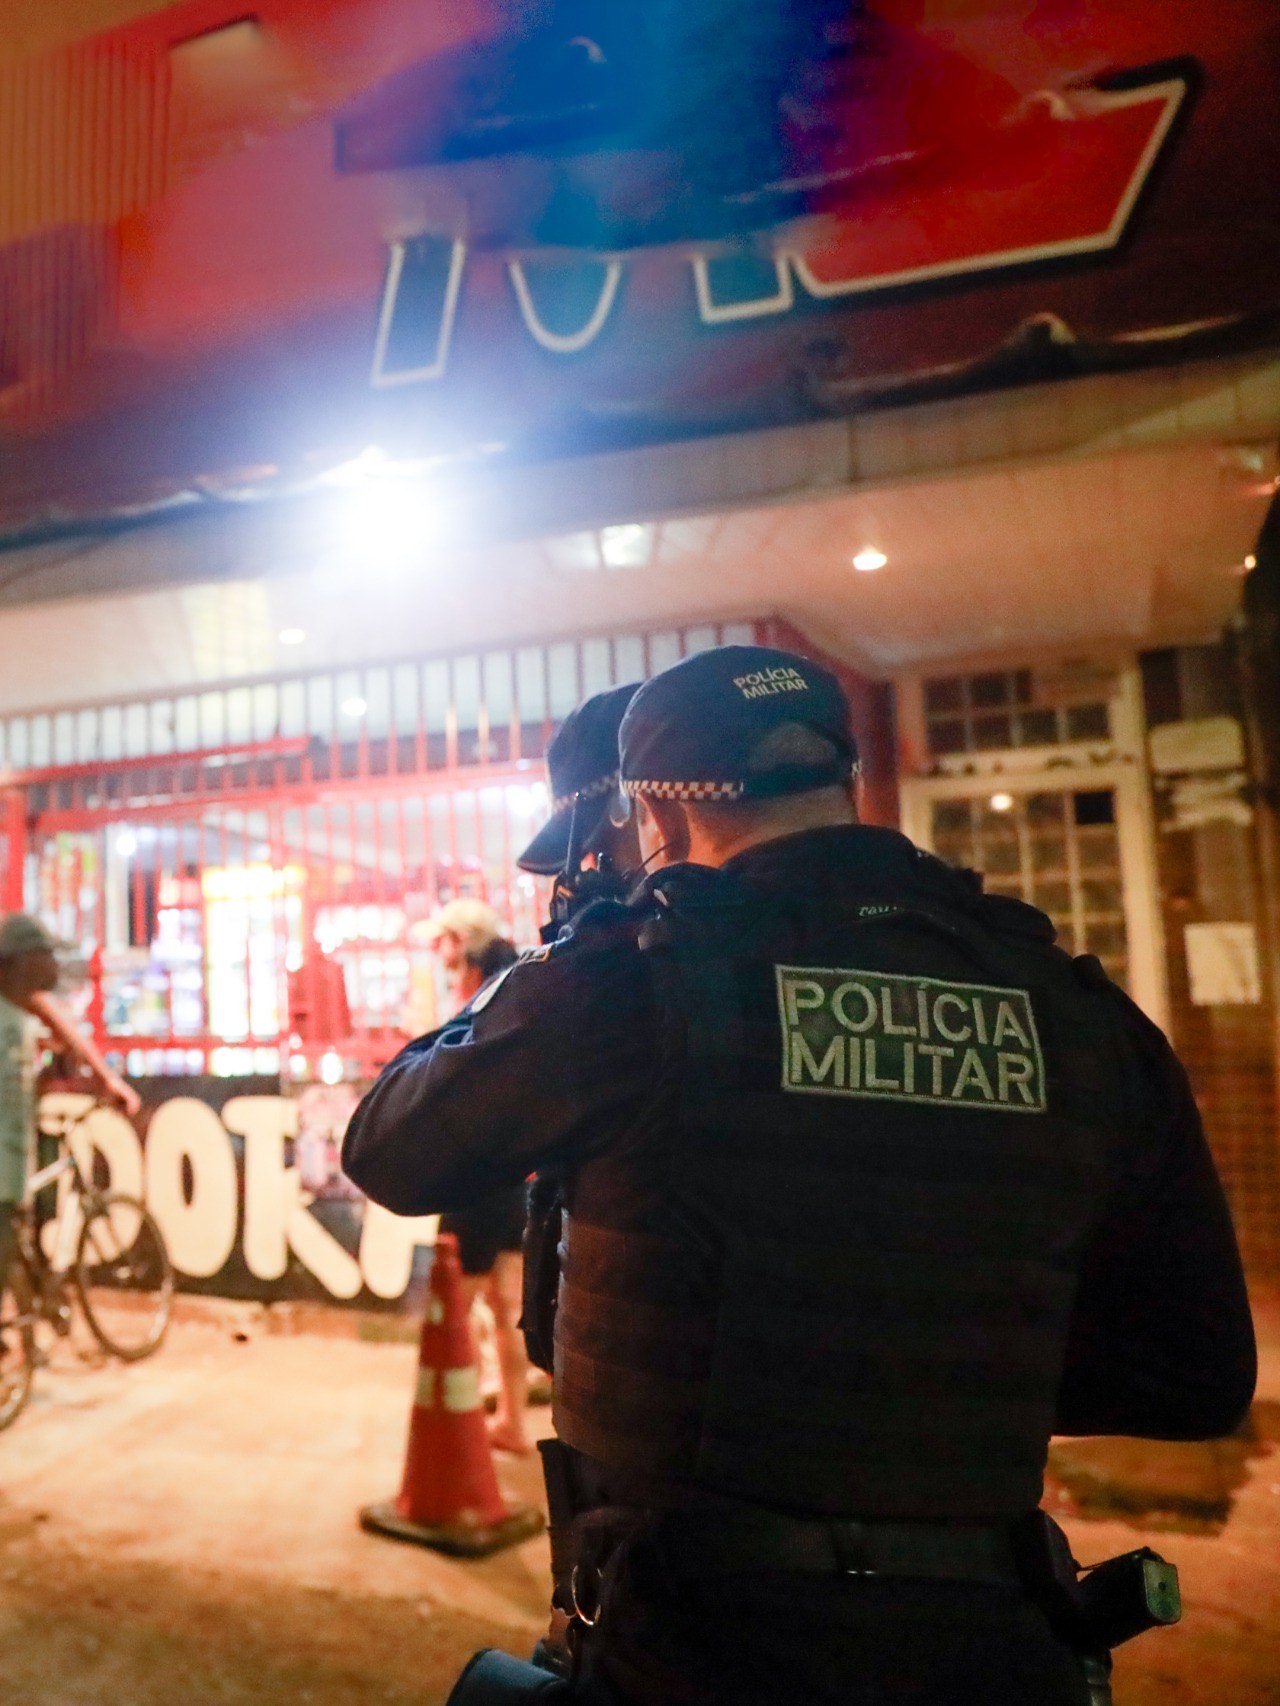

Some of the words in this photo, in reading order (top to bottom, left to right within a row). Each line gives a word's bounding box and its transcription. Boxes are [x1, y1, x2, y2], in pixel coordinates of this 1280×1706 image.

[732, 667, 801, 688] POLÍCIA
[742, 678, 809, 699] MILITAR
[783, 979, 1033, 1049] POLÍCIA
[790, 1031, 1035, 1105] MILITAR
